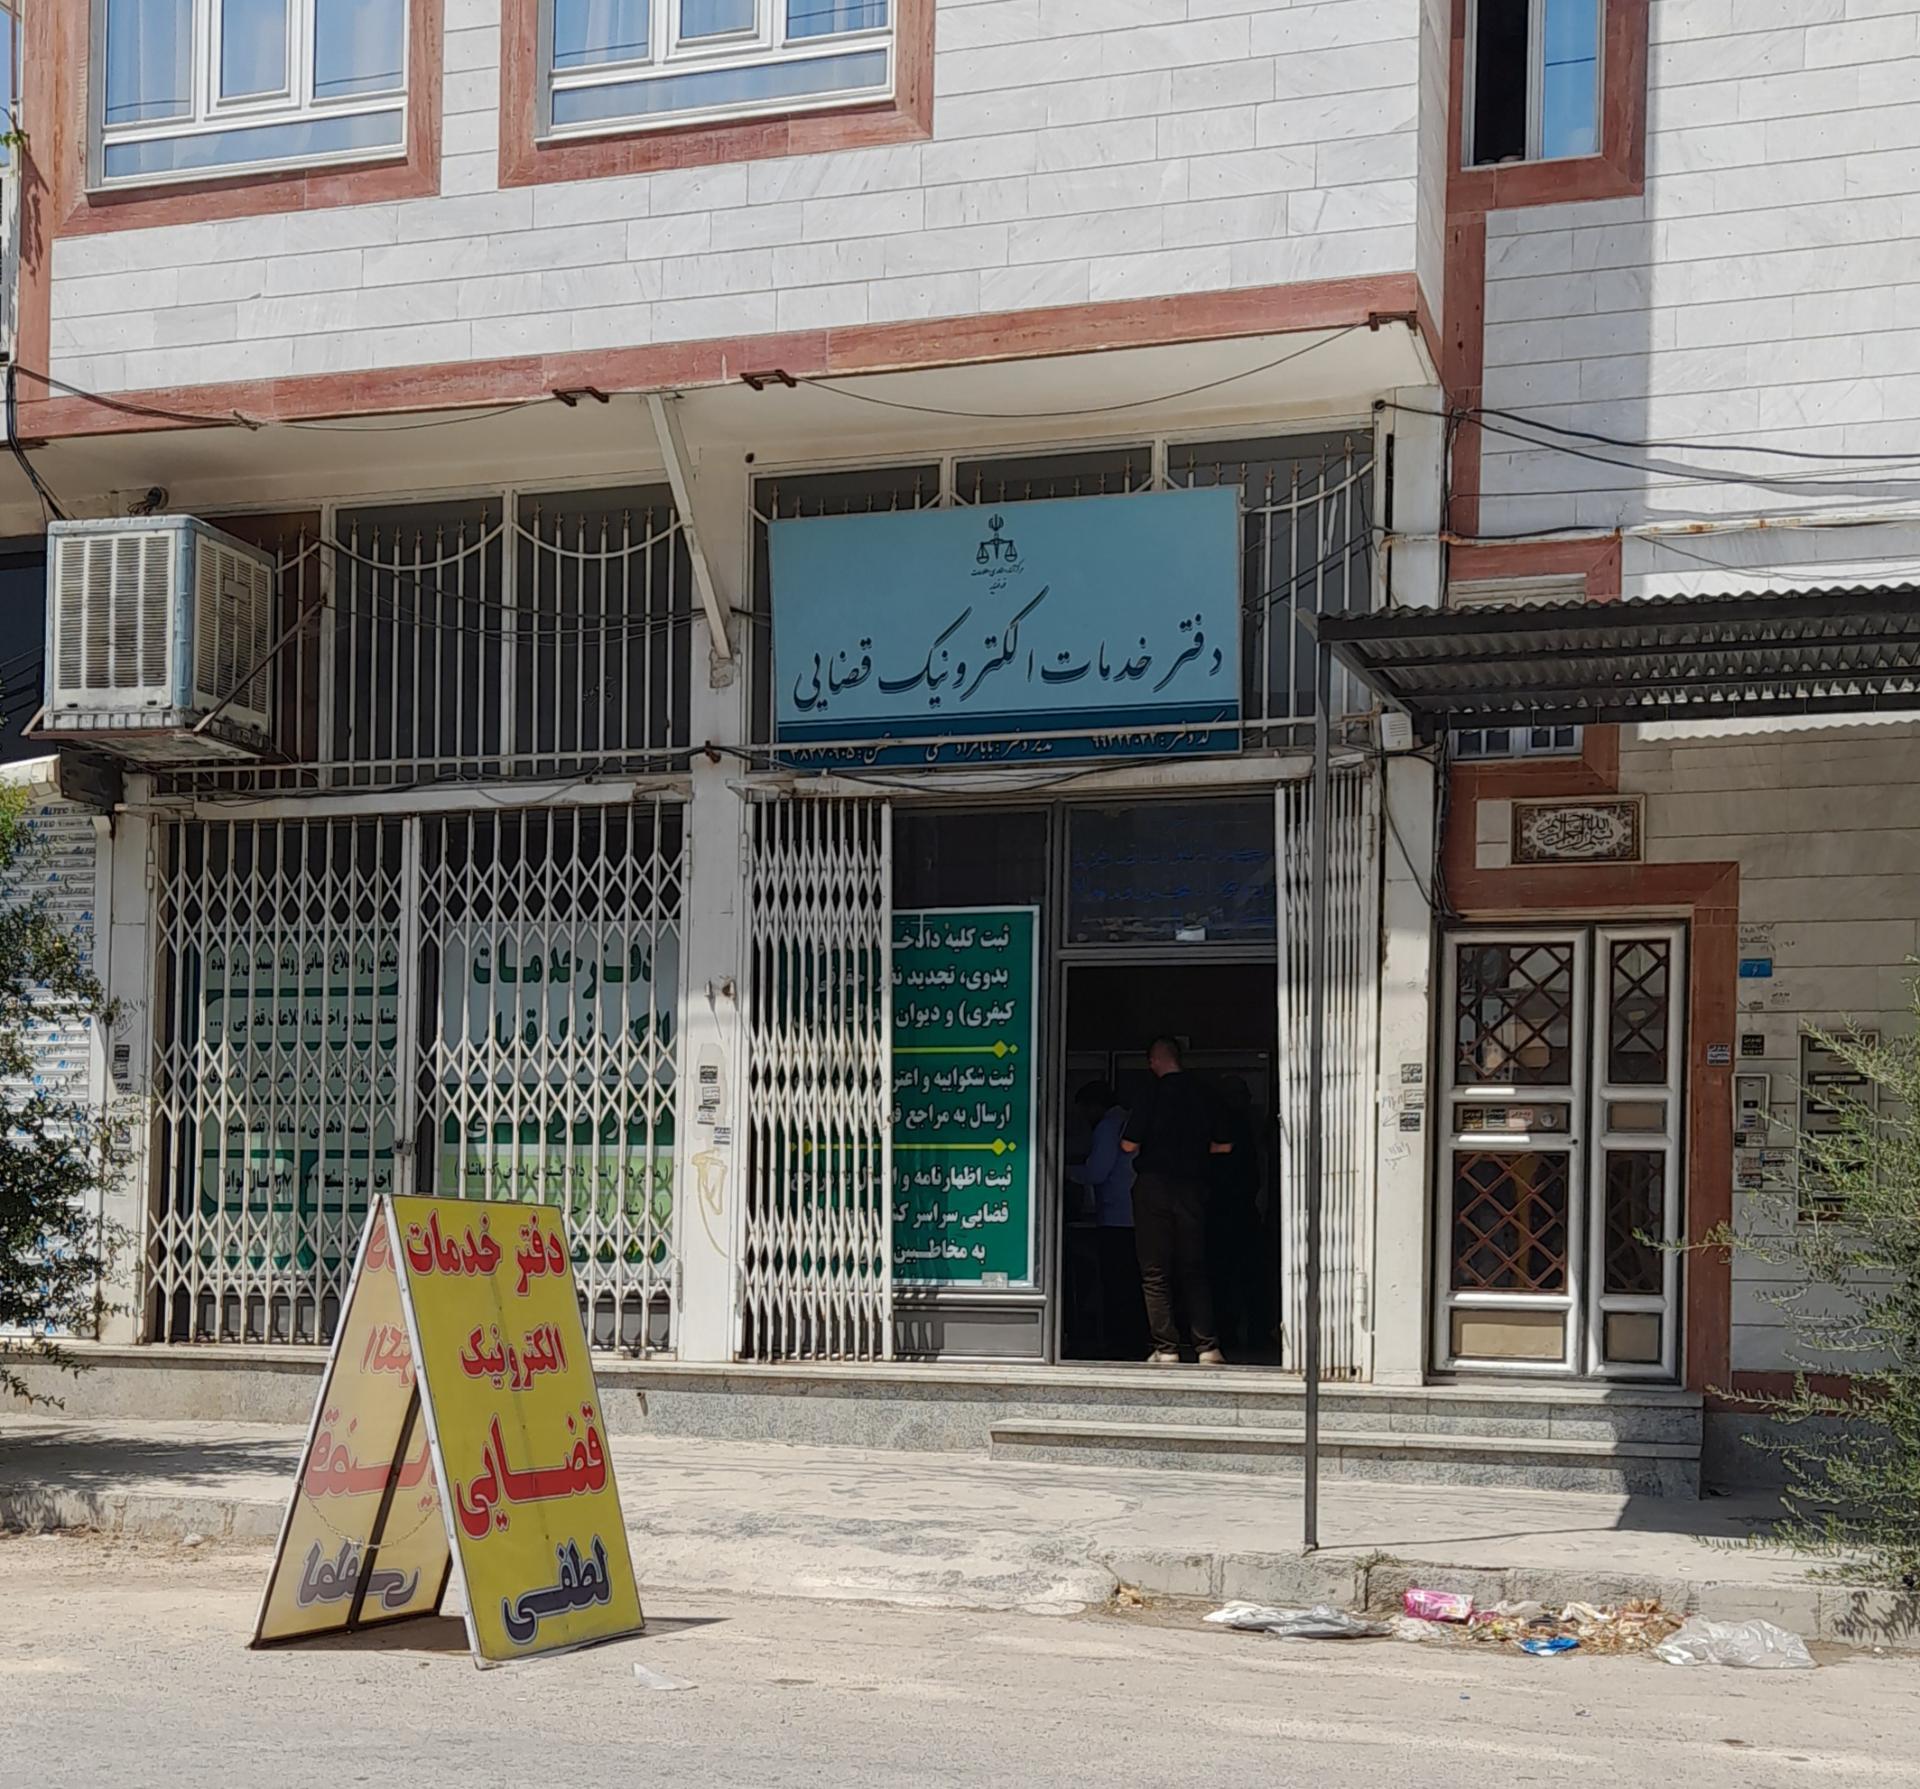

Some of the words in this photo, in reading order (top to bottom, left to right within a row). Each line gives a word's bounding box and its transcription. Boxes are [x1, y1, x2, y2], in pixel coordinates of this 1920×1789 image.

[878, 585, 1049, 710] الکترونیک
[1153, 614, 1223, 692] دفتر
[1040, 636, 1152, 685] خدمات
[981, 925, 1009, 951] ثبت
[907, 966, 955, 990] تجدید
[959, 968, 1008, 990] بدوی،
[895, 1003, 940, 1028] دیوان
[944, 1012, 954, 1027] و
[958, 1000, 1016, 1027] کیفری)
[922, 1077, 930, 1093] و
[988, 1065, 1014, 1090] ثبت
[905, 1104, 949, 1129] مراجع
[953, 1111, 967, 1127] به
[970, 1103, 1011, 1128] ارسال
[902, 1174, 910, 1192] و
[985, 1165, 1012, 1190] ثبت
[913, 1203, 958, 1228] سراسر
[961, 1202, 1009, 1228] قضایی
[405, 1208, 501, 1277] خدمات
[515, 1210, 567, 1296] دفتر
[972, 1245, 985, 1264] به
[459, 1322, 568, 1391] الکترونیک
[455, 1402, 609, 1540] قضایی
[502, 1533, 611, 1646] لطفی
